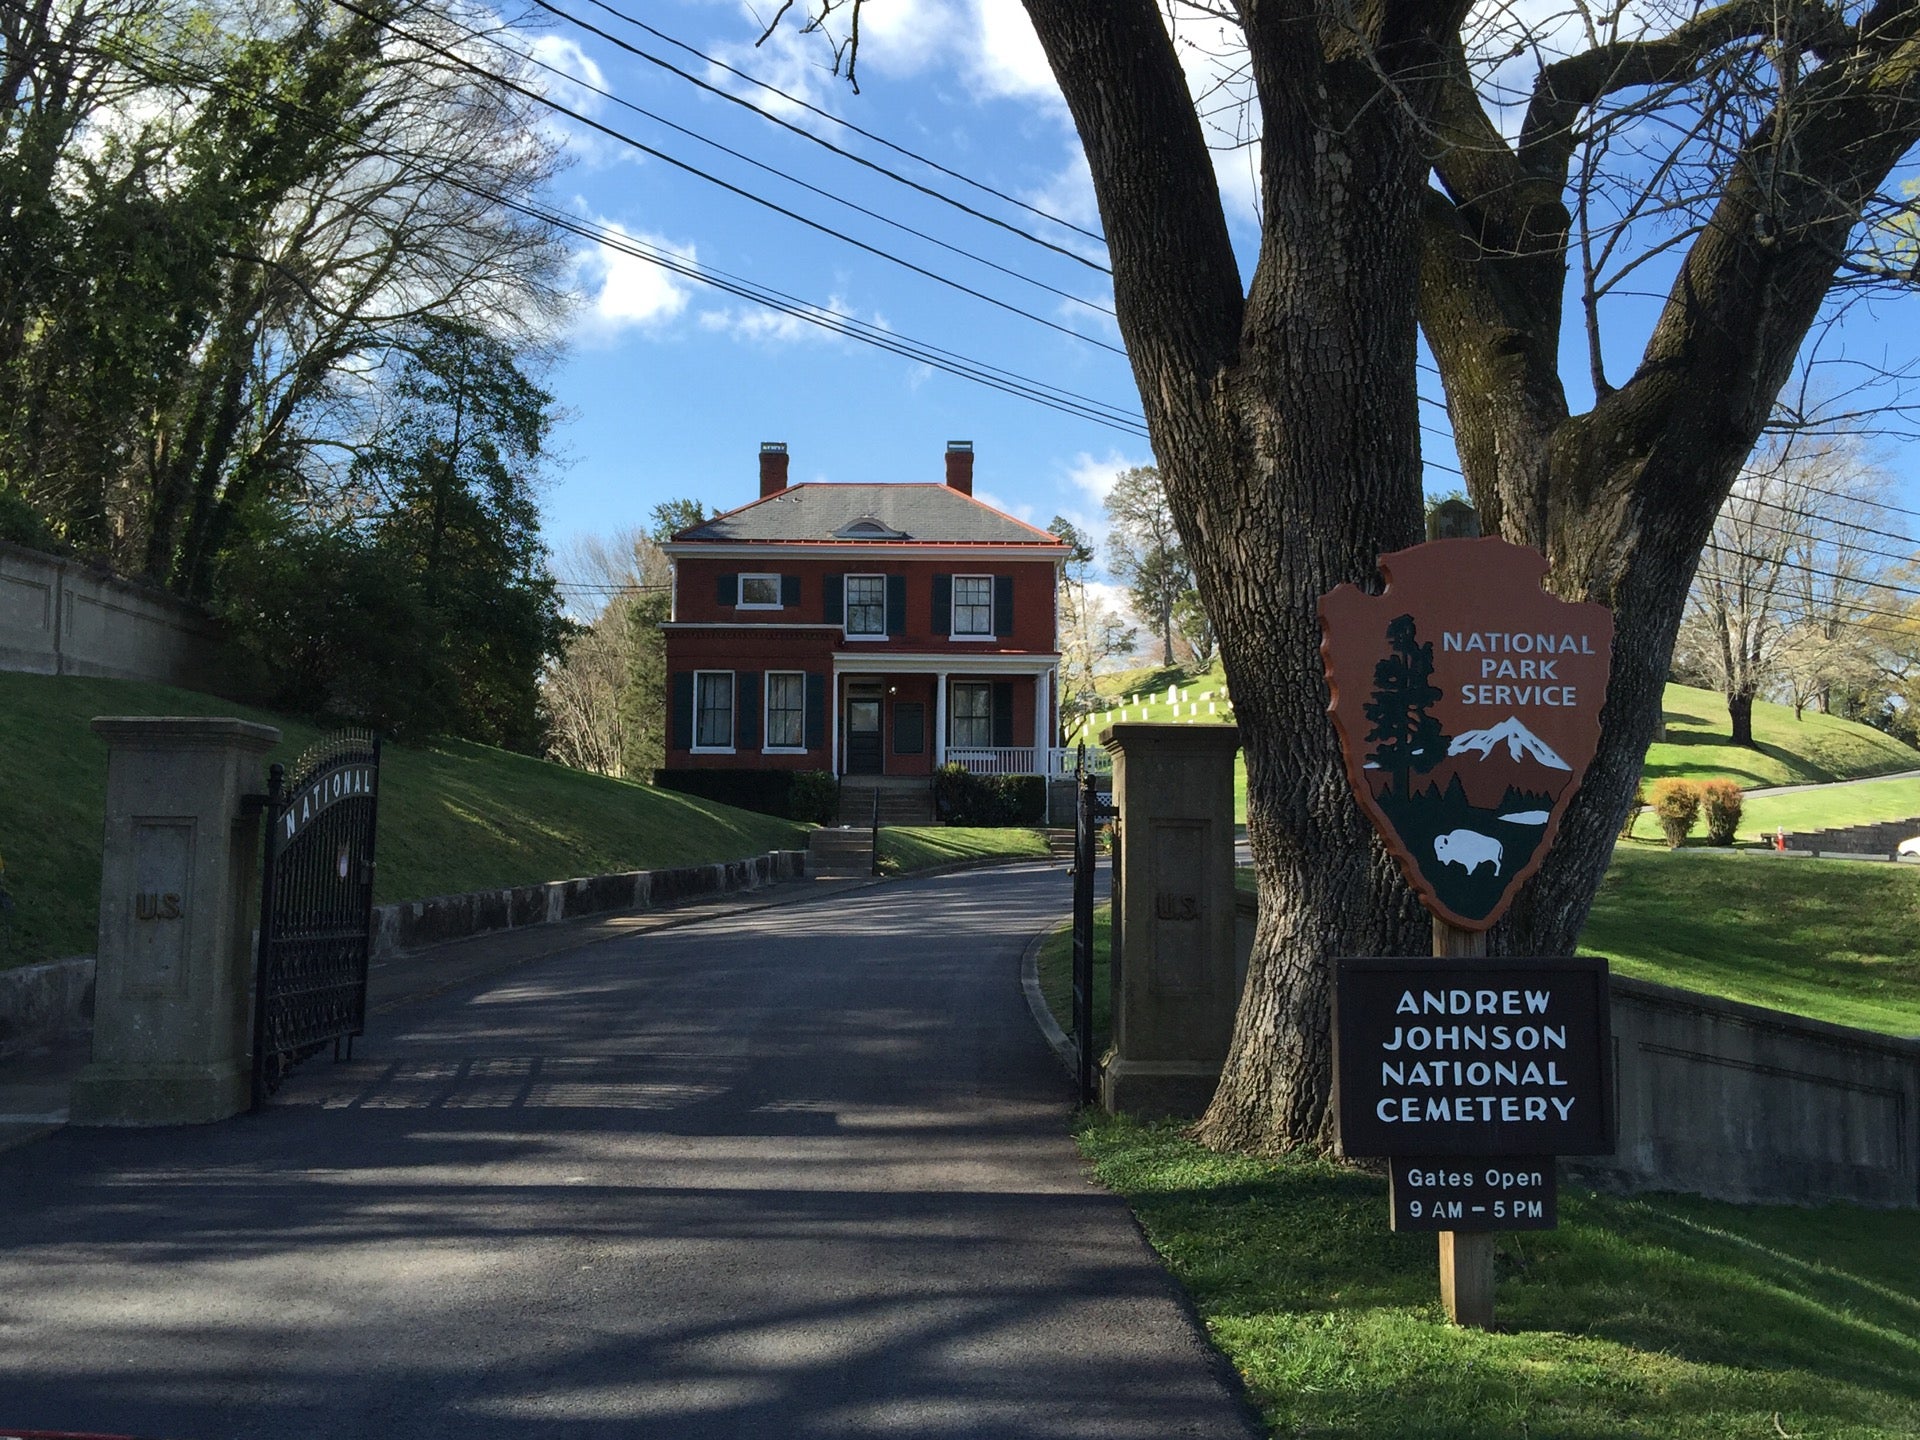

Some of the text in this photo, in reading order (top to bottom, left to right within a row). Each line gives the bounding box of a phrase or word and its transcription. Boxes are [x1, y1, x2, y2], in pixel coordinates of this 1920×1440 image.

[1444, 632, 1595, 654] NATIONAL
[1482, 659, 1558, 679] PARK
[1462, 685, 1576, 705] SERVICE
[287, 771, 369, 838] NATIONAL
[1397, 990, 1549, 1014] ANDREW
[1383, 1025, 1565, 1050] JOHNSON
[1383, 1061, 1567, 1086] NATIONAL
[1377, 1097, 1575, 1122] CEMETERY
[1408, 1169, 1541, 1189] Gates Open
[1410, 1201, 1422, 1217] 9
[1432, 1202, 1462, 1218] AM
[1494, 1201, 1505, 1217] 5
[1514, 1201, 1542, 1217] PM
